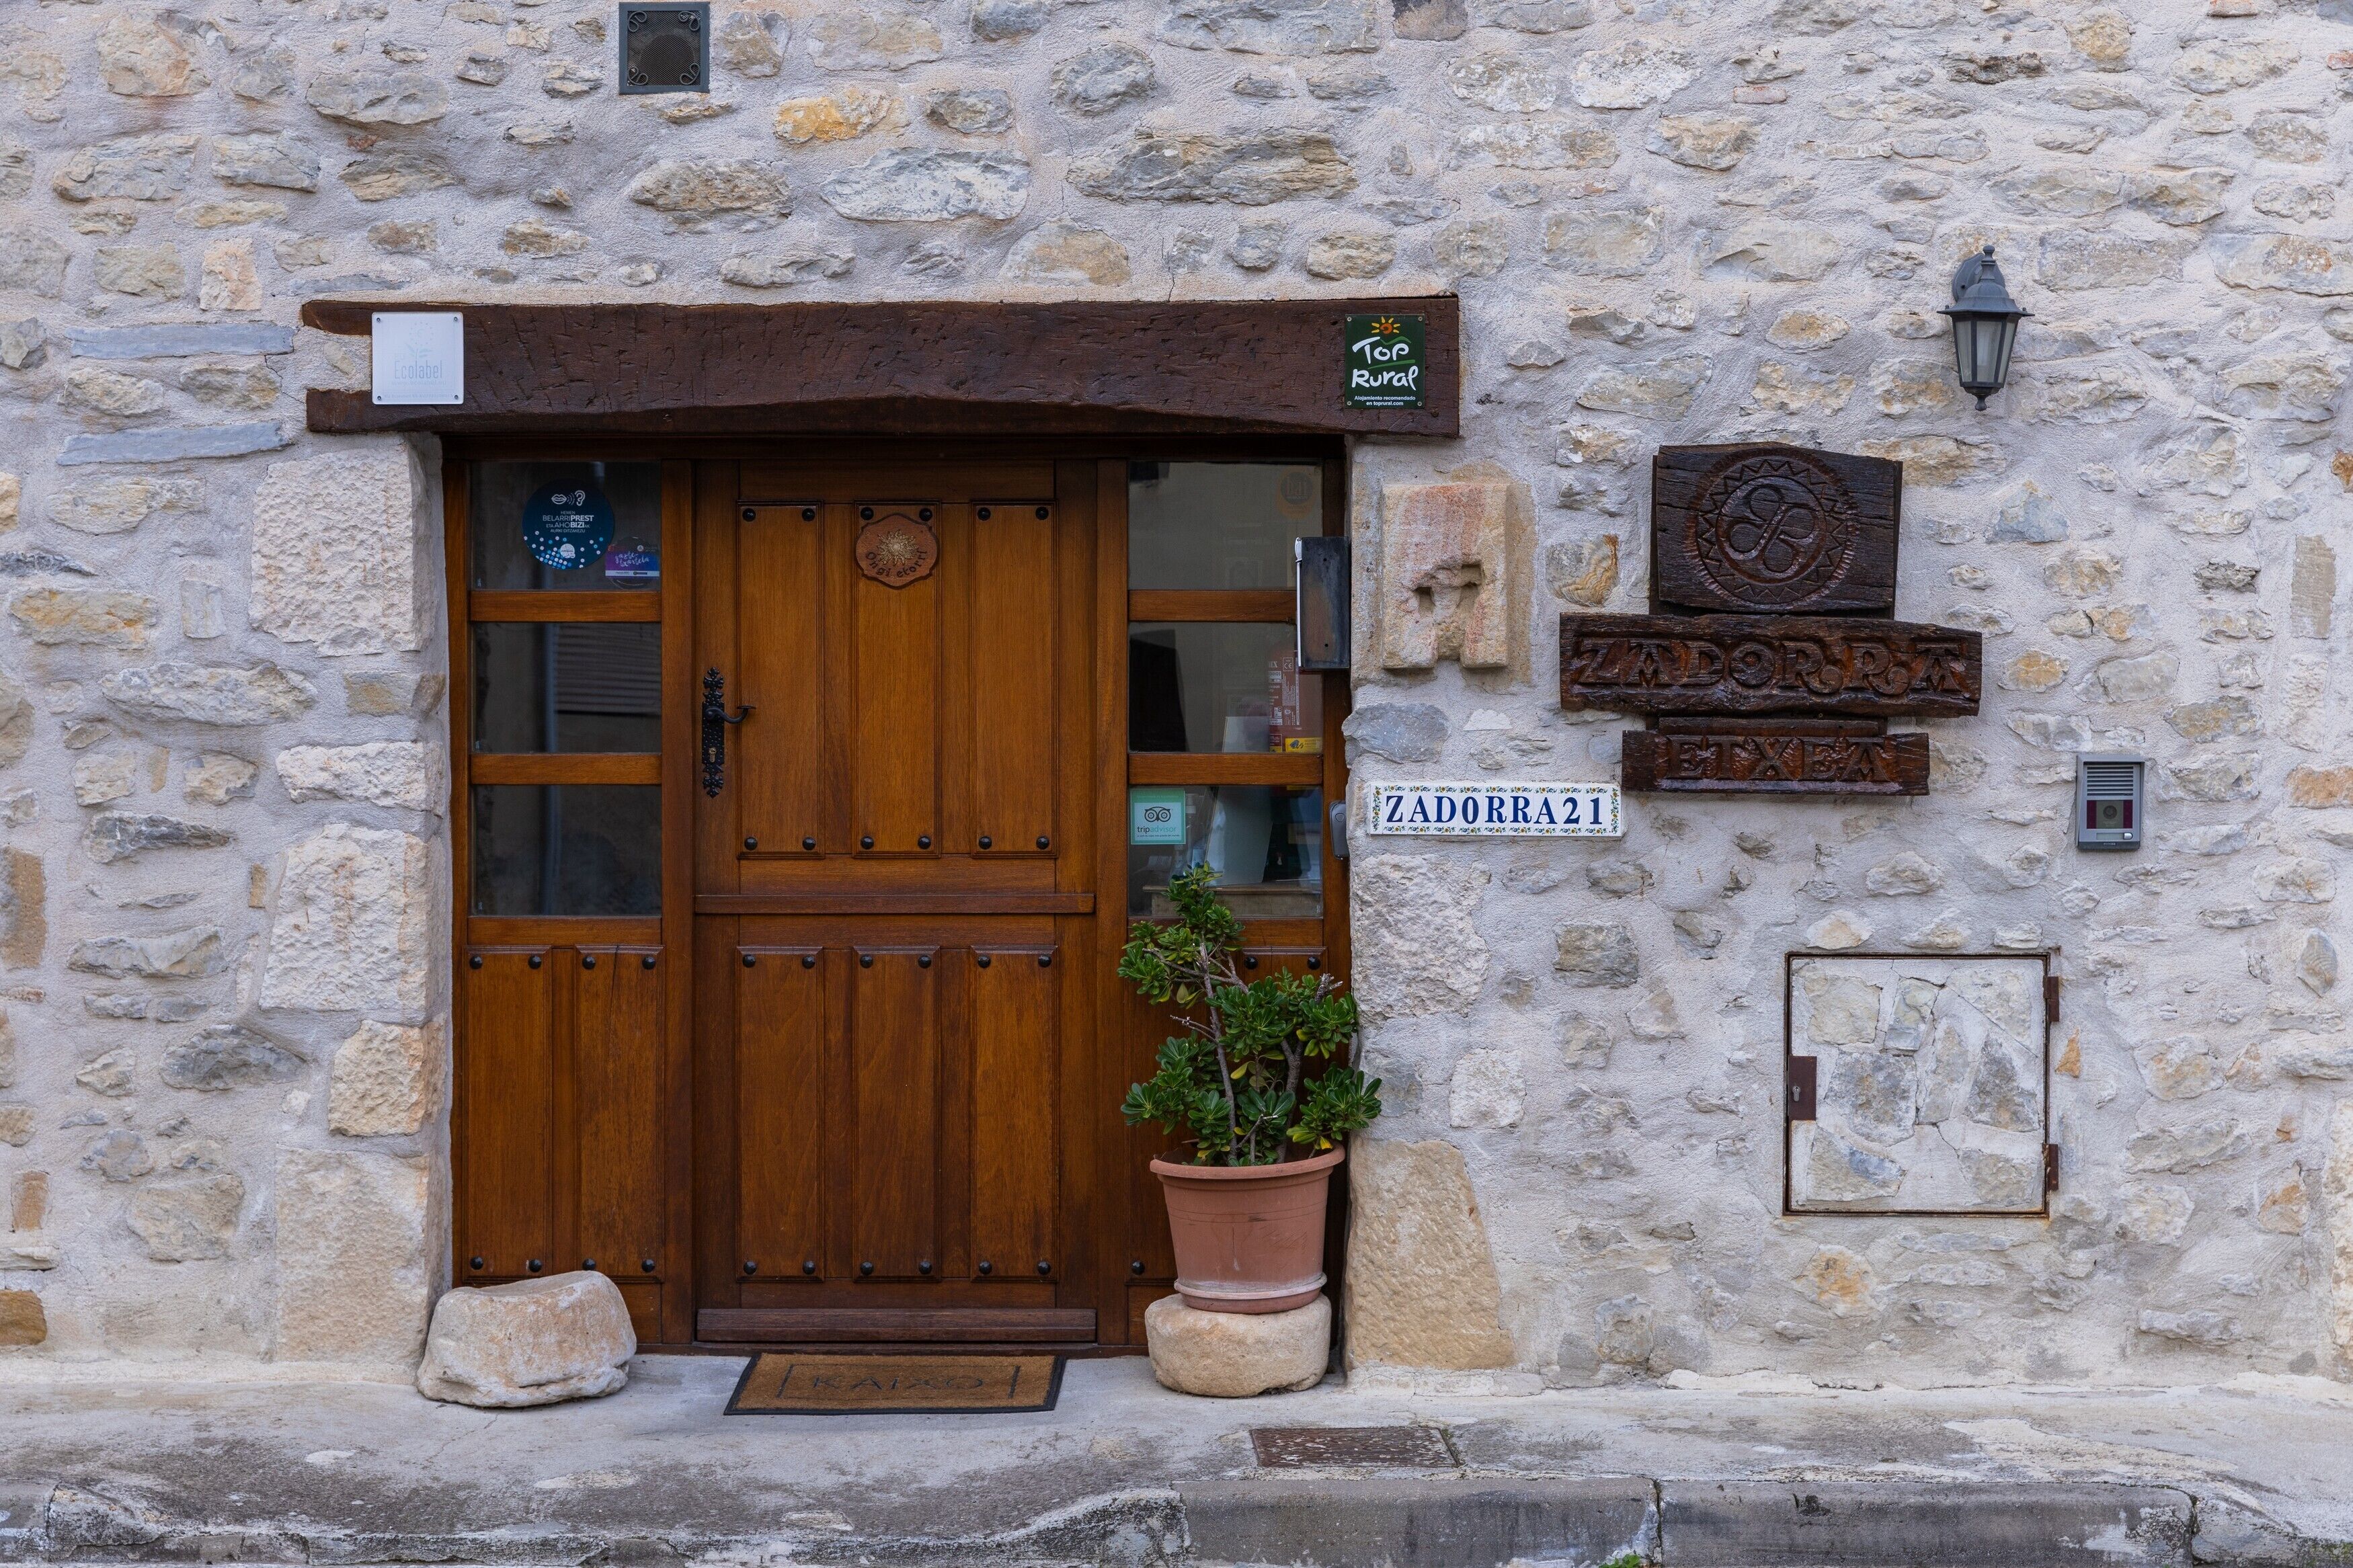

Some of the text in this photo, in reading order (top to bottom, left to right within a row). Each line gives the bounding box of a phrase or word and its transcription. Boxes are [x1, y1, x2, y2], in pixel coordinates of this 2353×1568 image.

[1351, 336, 1410, 364] Top
[393, 360, 443, 380] Ecolabel
[1351, 365, 1419, 391] Rural
[865, 549, 928, 577] Ongi etorri
[1574, 636, 1974, 696] ZADORRA
[1669, 735, 1890, 781] ETXEA
[1136, 825, 1176, 834] tripadvisor
[812, 1374, 985, 1391] KAIXO
